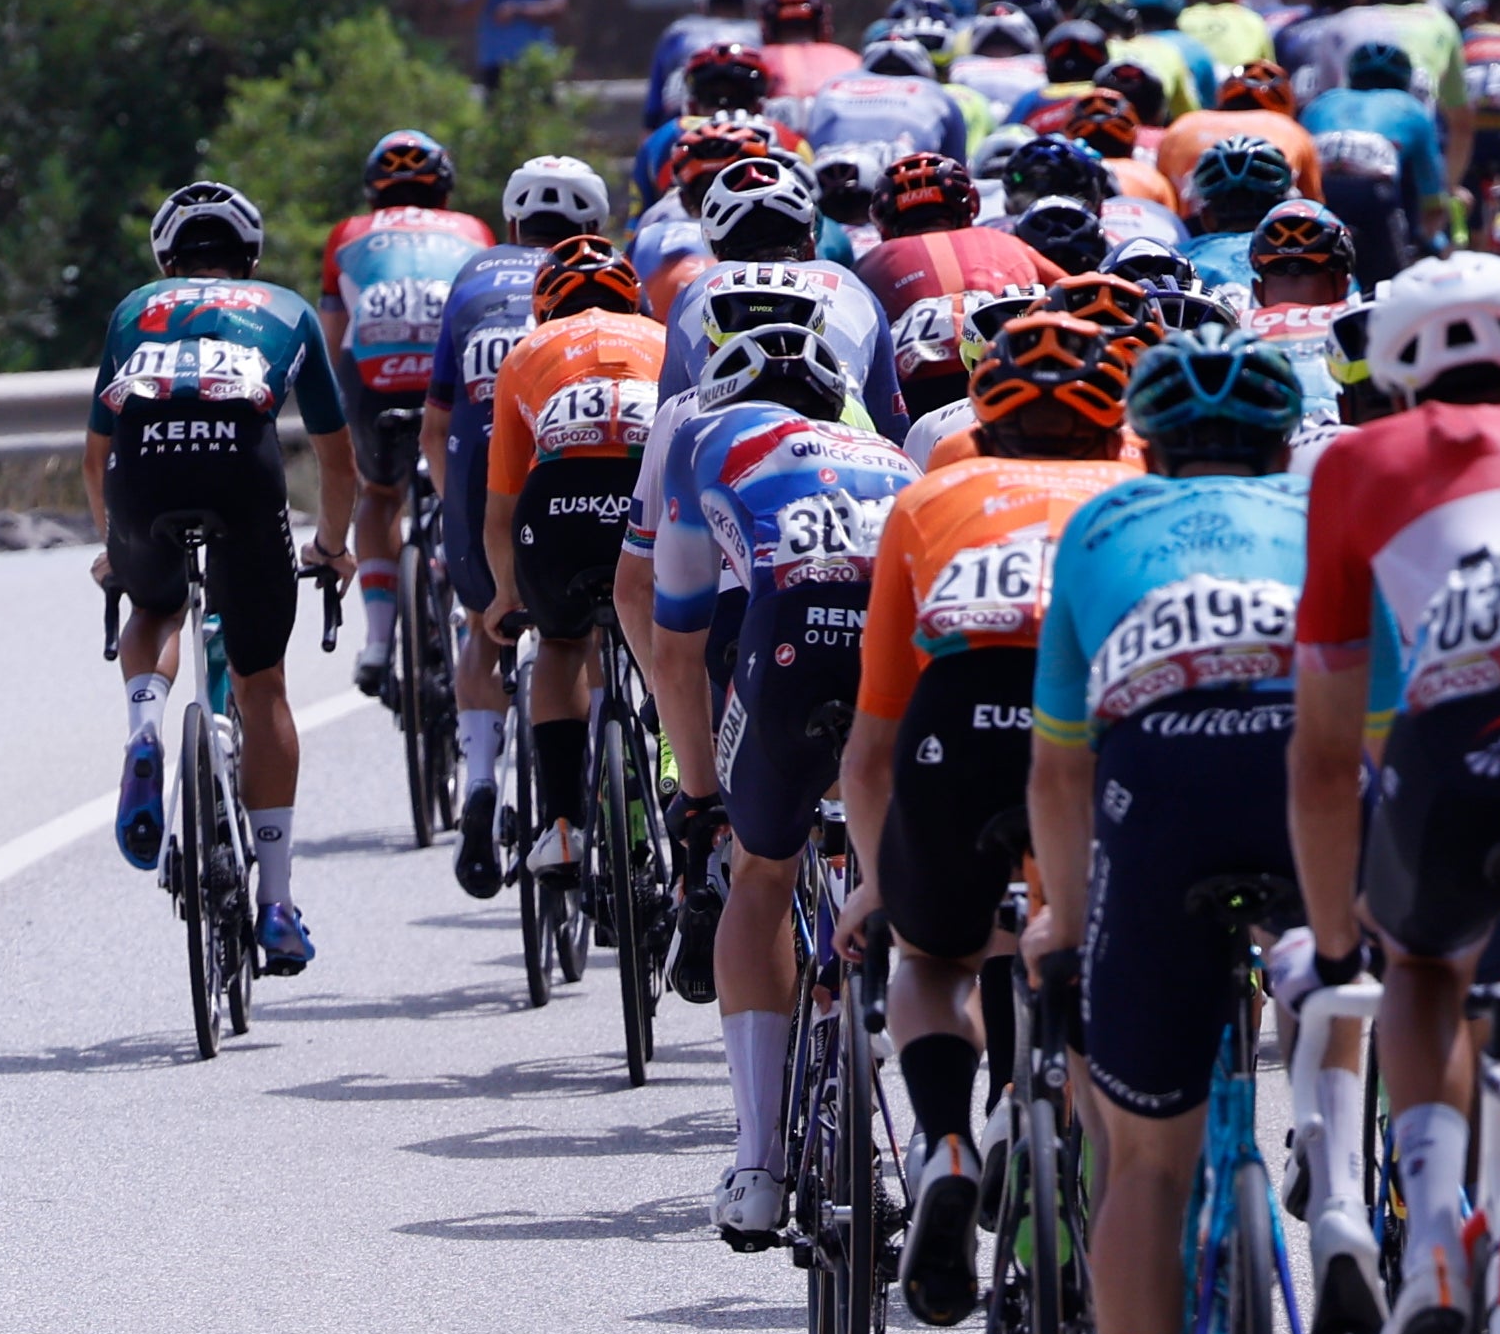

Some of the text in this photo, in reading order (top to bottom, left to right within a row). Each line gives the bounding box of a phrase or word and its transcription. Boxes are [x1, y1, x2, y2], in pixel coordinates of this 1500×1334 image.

[147, 286, 263, 309] KERN
[749, 305, 773, 313] uvex
[541, 386, 606, 432] 213
[142, 421, 236, 443] KERN
[140, 441, 238, 456] PHARMA
[789, 506, 851, 555] 36
[933, 551, 1031, 603] 216
